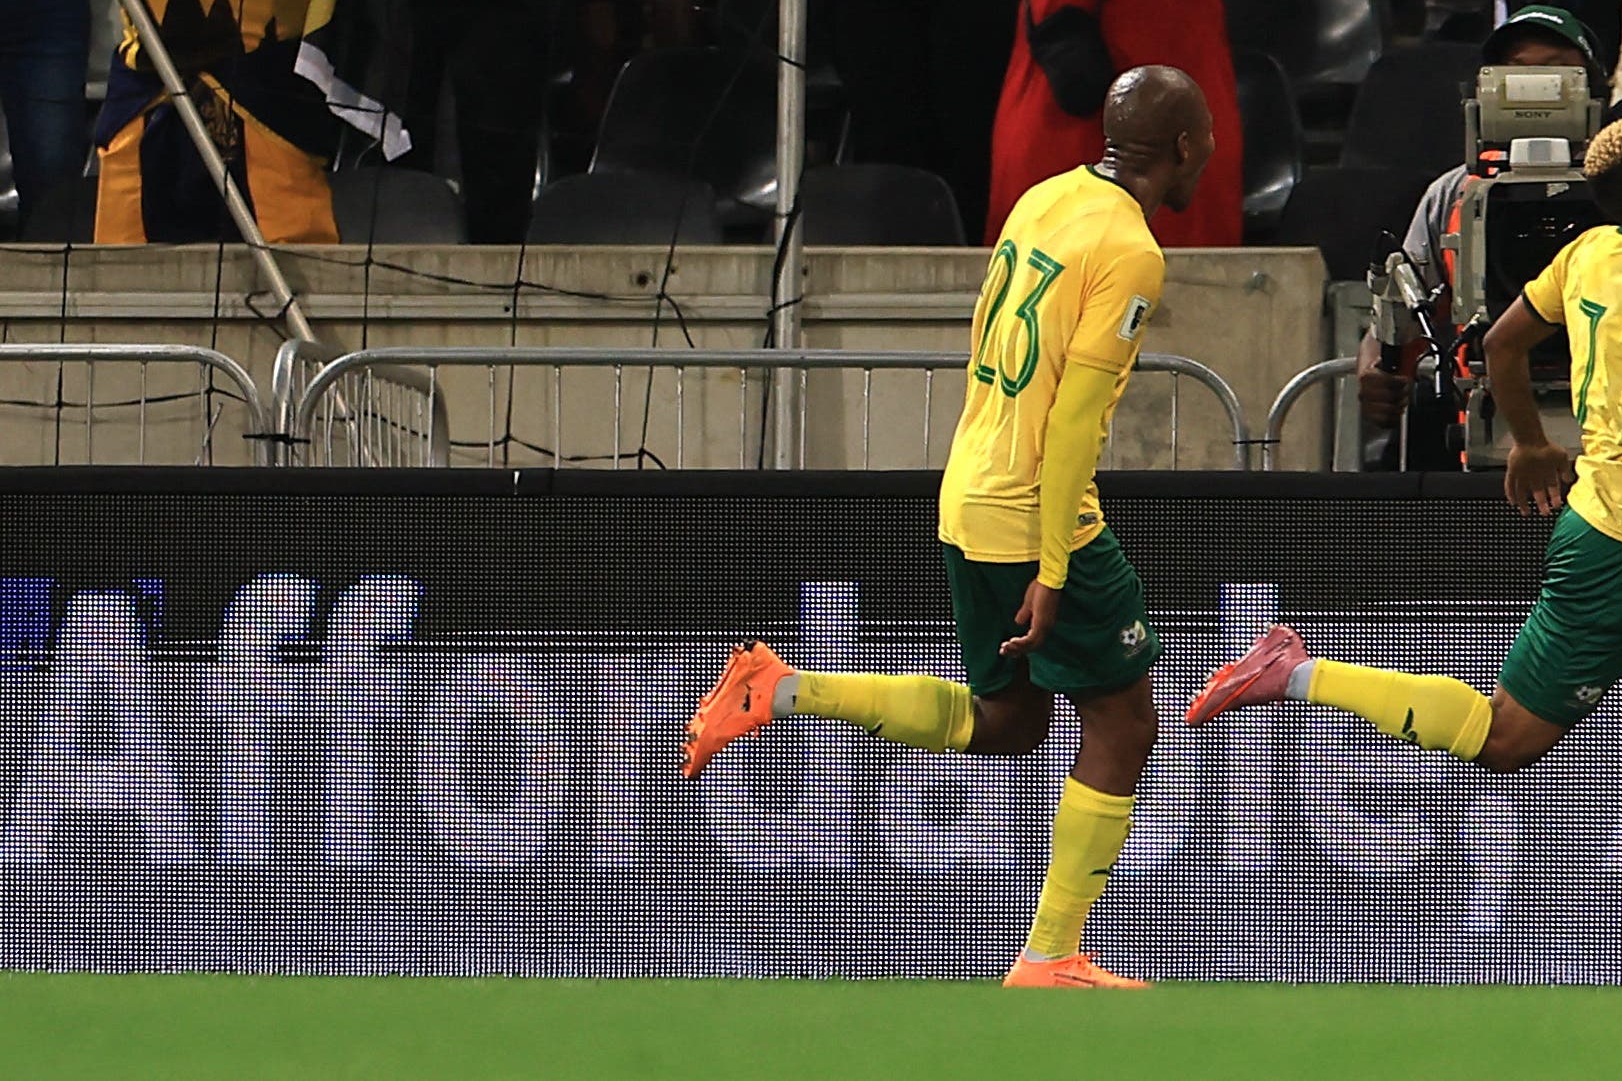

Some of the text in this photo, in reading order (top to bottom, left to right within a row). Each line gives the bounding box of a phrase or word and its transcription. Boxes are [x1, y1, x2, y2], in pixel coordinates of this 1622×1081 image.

[1514, 111, 1552, 119] SONY
[973, 239, 1066, 398] 23
[1577, 297, 1608, 426] 7
